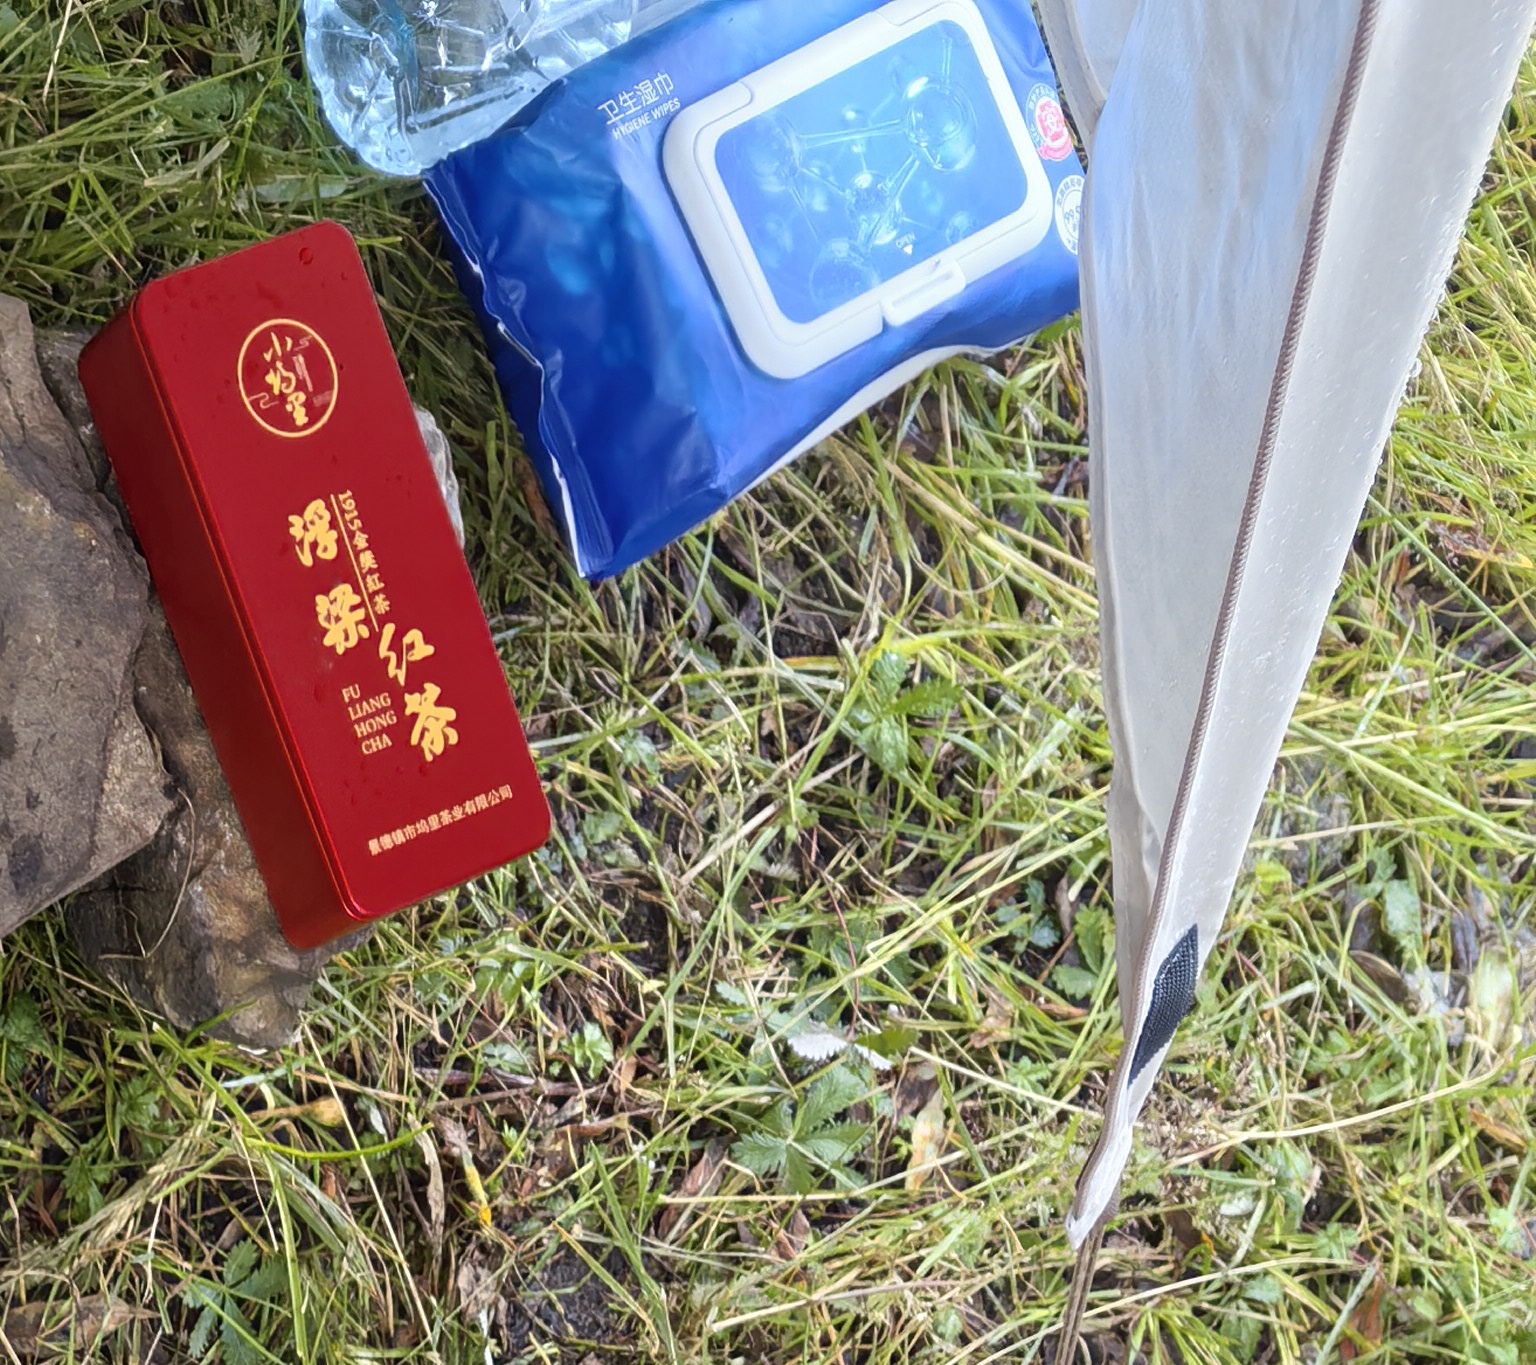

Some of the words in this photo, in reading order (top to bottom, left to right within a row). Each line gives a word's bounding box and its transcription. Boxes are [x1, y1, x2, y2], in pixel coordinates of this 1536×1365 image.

[597, 72, 674, 125] 卫生湿巾
[611, 111, 652, 140] HYGIENE
[650, 97, 681, 120] WIPES
[287, 497, 370, 656] 浮梁
[341, 686, 362, 703] FU
[347, 692, 393, 721] LIANG
[377, 622, 460, 762] 红茶
[353, 710, 399, 739] HONG
[360, 733, 394, 757] CHA
